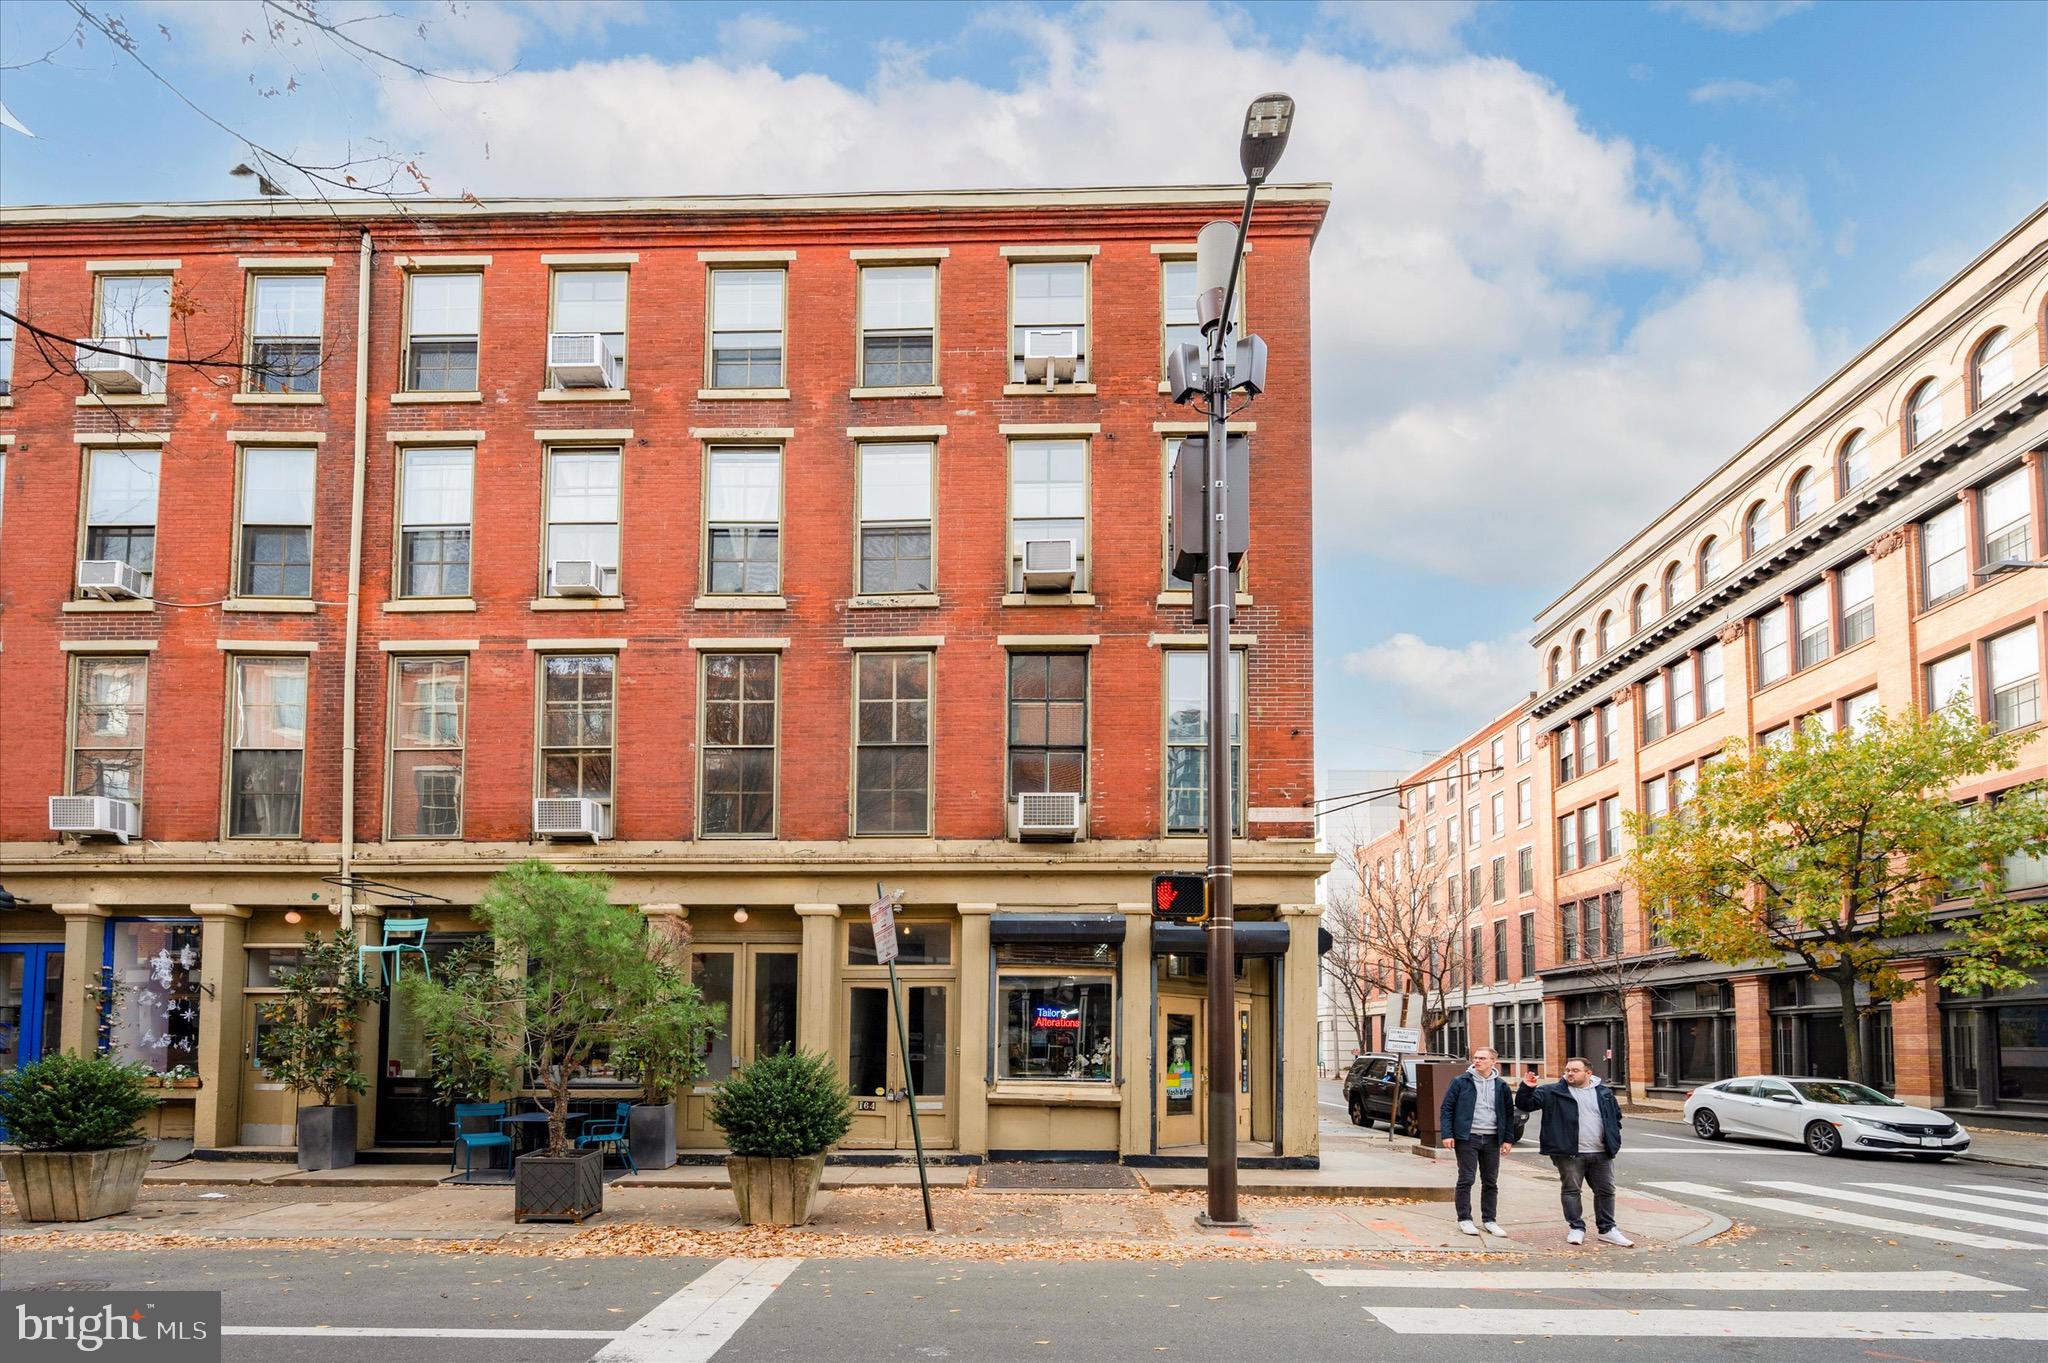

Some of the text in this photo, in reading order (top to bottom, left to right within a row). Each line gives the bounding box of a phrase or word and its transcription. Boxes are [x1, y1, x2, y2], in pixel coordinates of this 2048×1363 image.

[1037, 1008, 1060, 1017] Tailor
[1035, 1017, 1080, 1027] Alterations
[859, 1101, 875, 1110] 164
